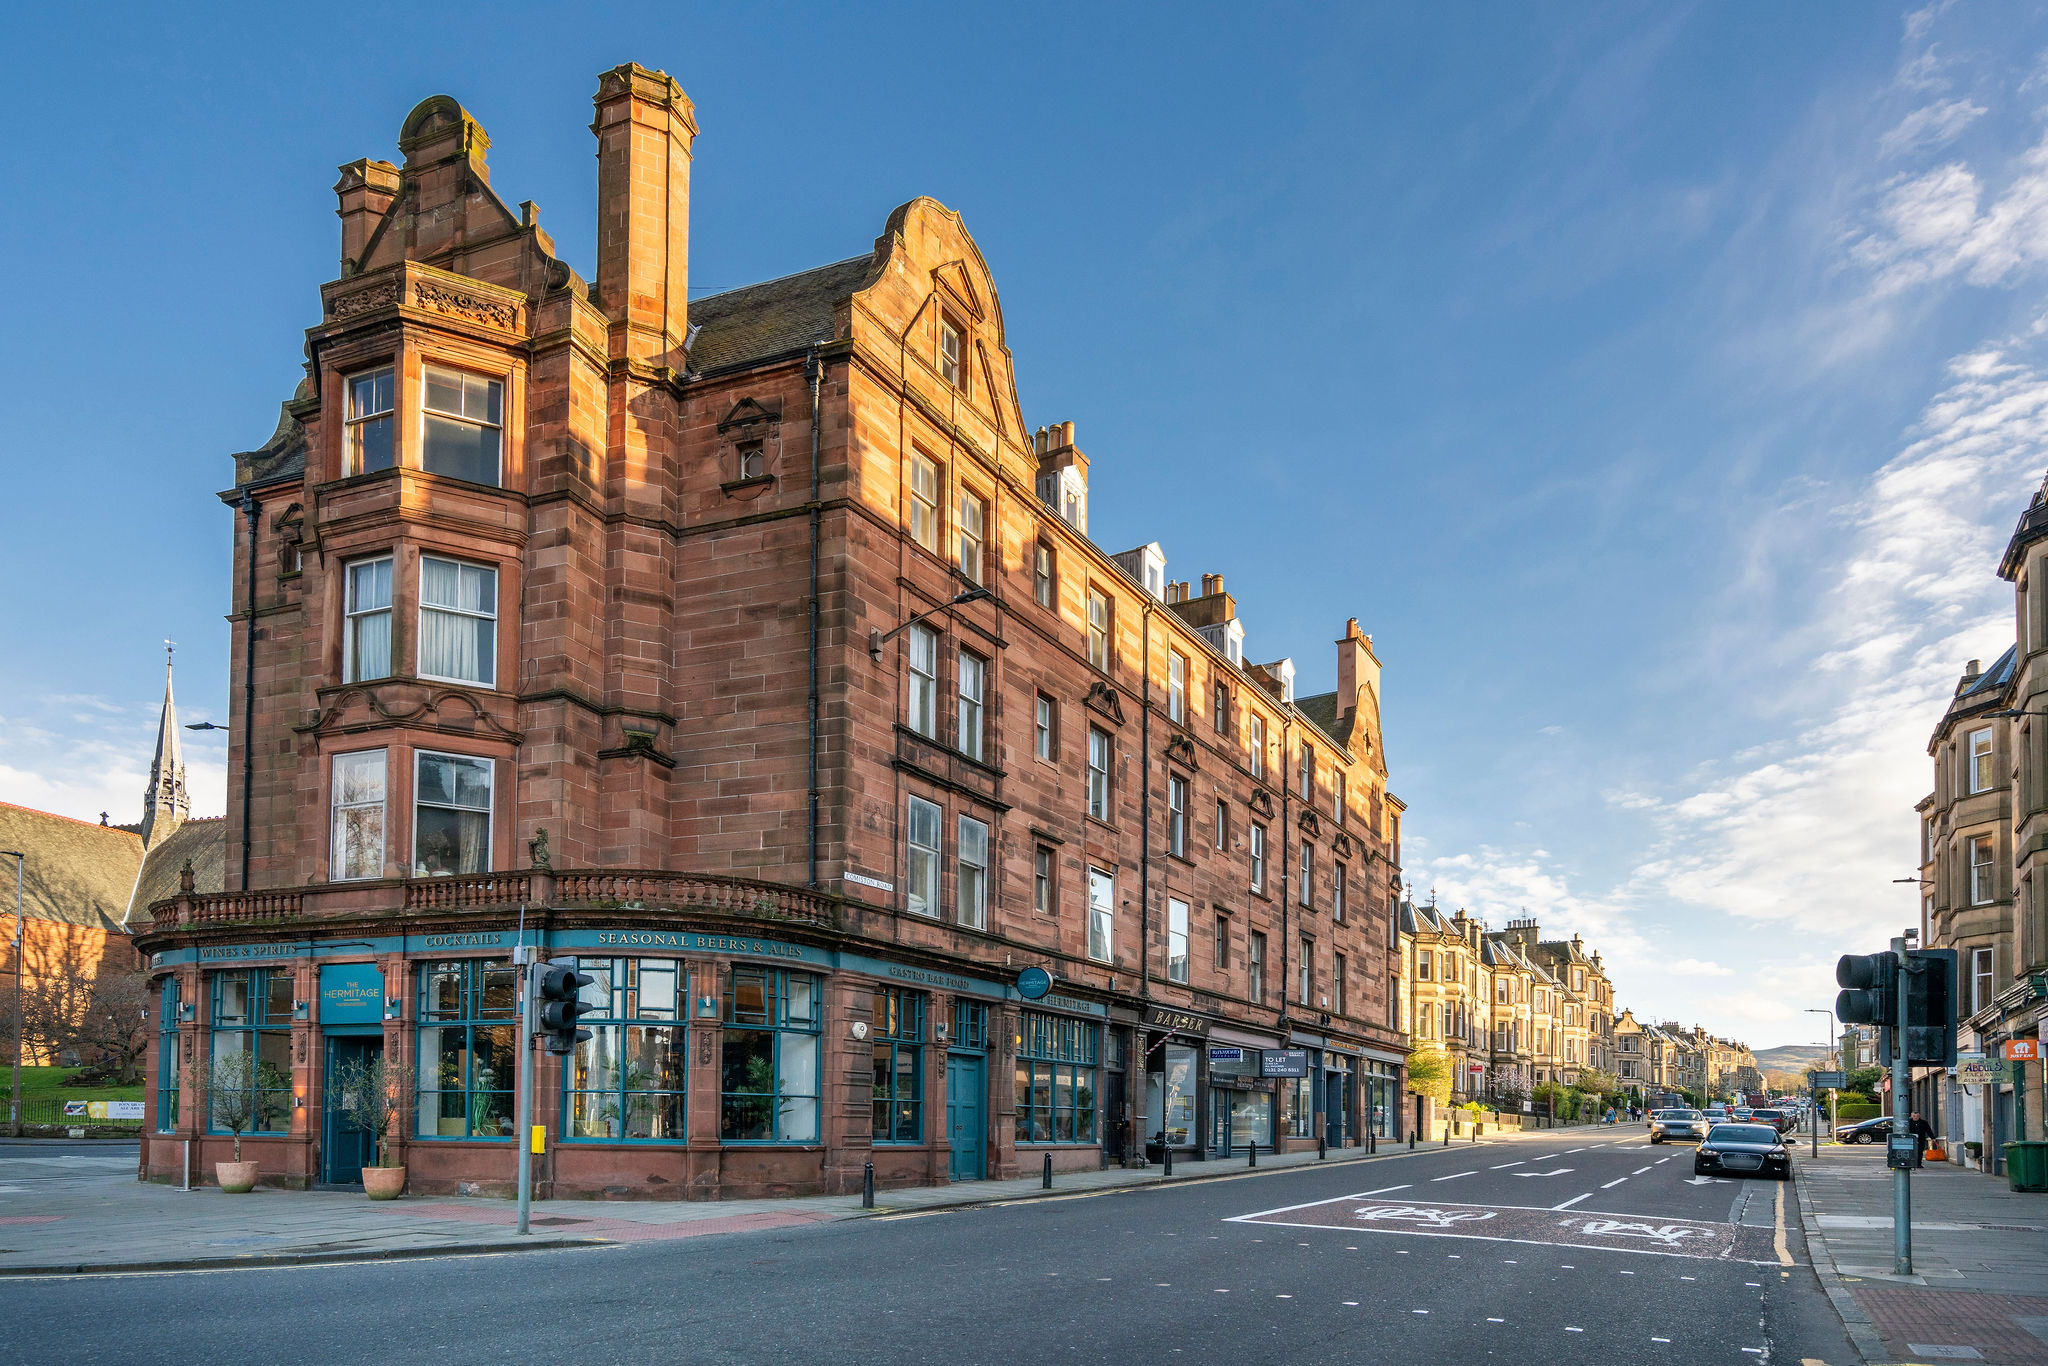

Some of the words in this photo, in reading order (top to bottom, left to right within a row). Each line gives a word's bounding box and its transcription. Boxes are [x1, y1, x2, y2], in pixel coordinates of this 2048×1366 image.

[846, 873, 876, 885] COMISTON
[876, 880, 892, 890] ROAD
[425, 934, 500, 947] COCKTAILS
[599, 933, 689, 947] SEASONAL
[696, 937, 747, 951] BEERS
[753, 942, 763, 952] &
[768, 944, 802, 957] ALES
[201, 947, 237, 958] WINES
[241, 947, 248, 956] &
[252, 944, 297, 956] SPIRITS
[889, 967, 926, 981] GASTRO
[928, 973, 946, 985] BAR
[947, 976, 971, 989] FOOD
[324, 988, 380, 999] HERMITAGE
